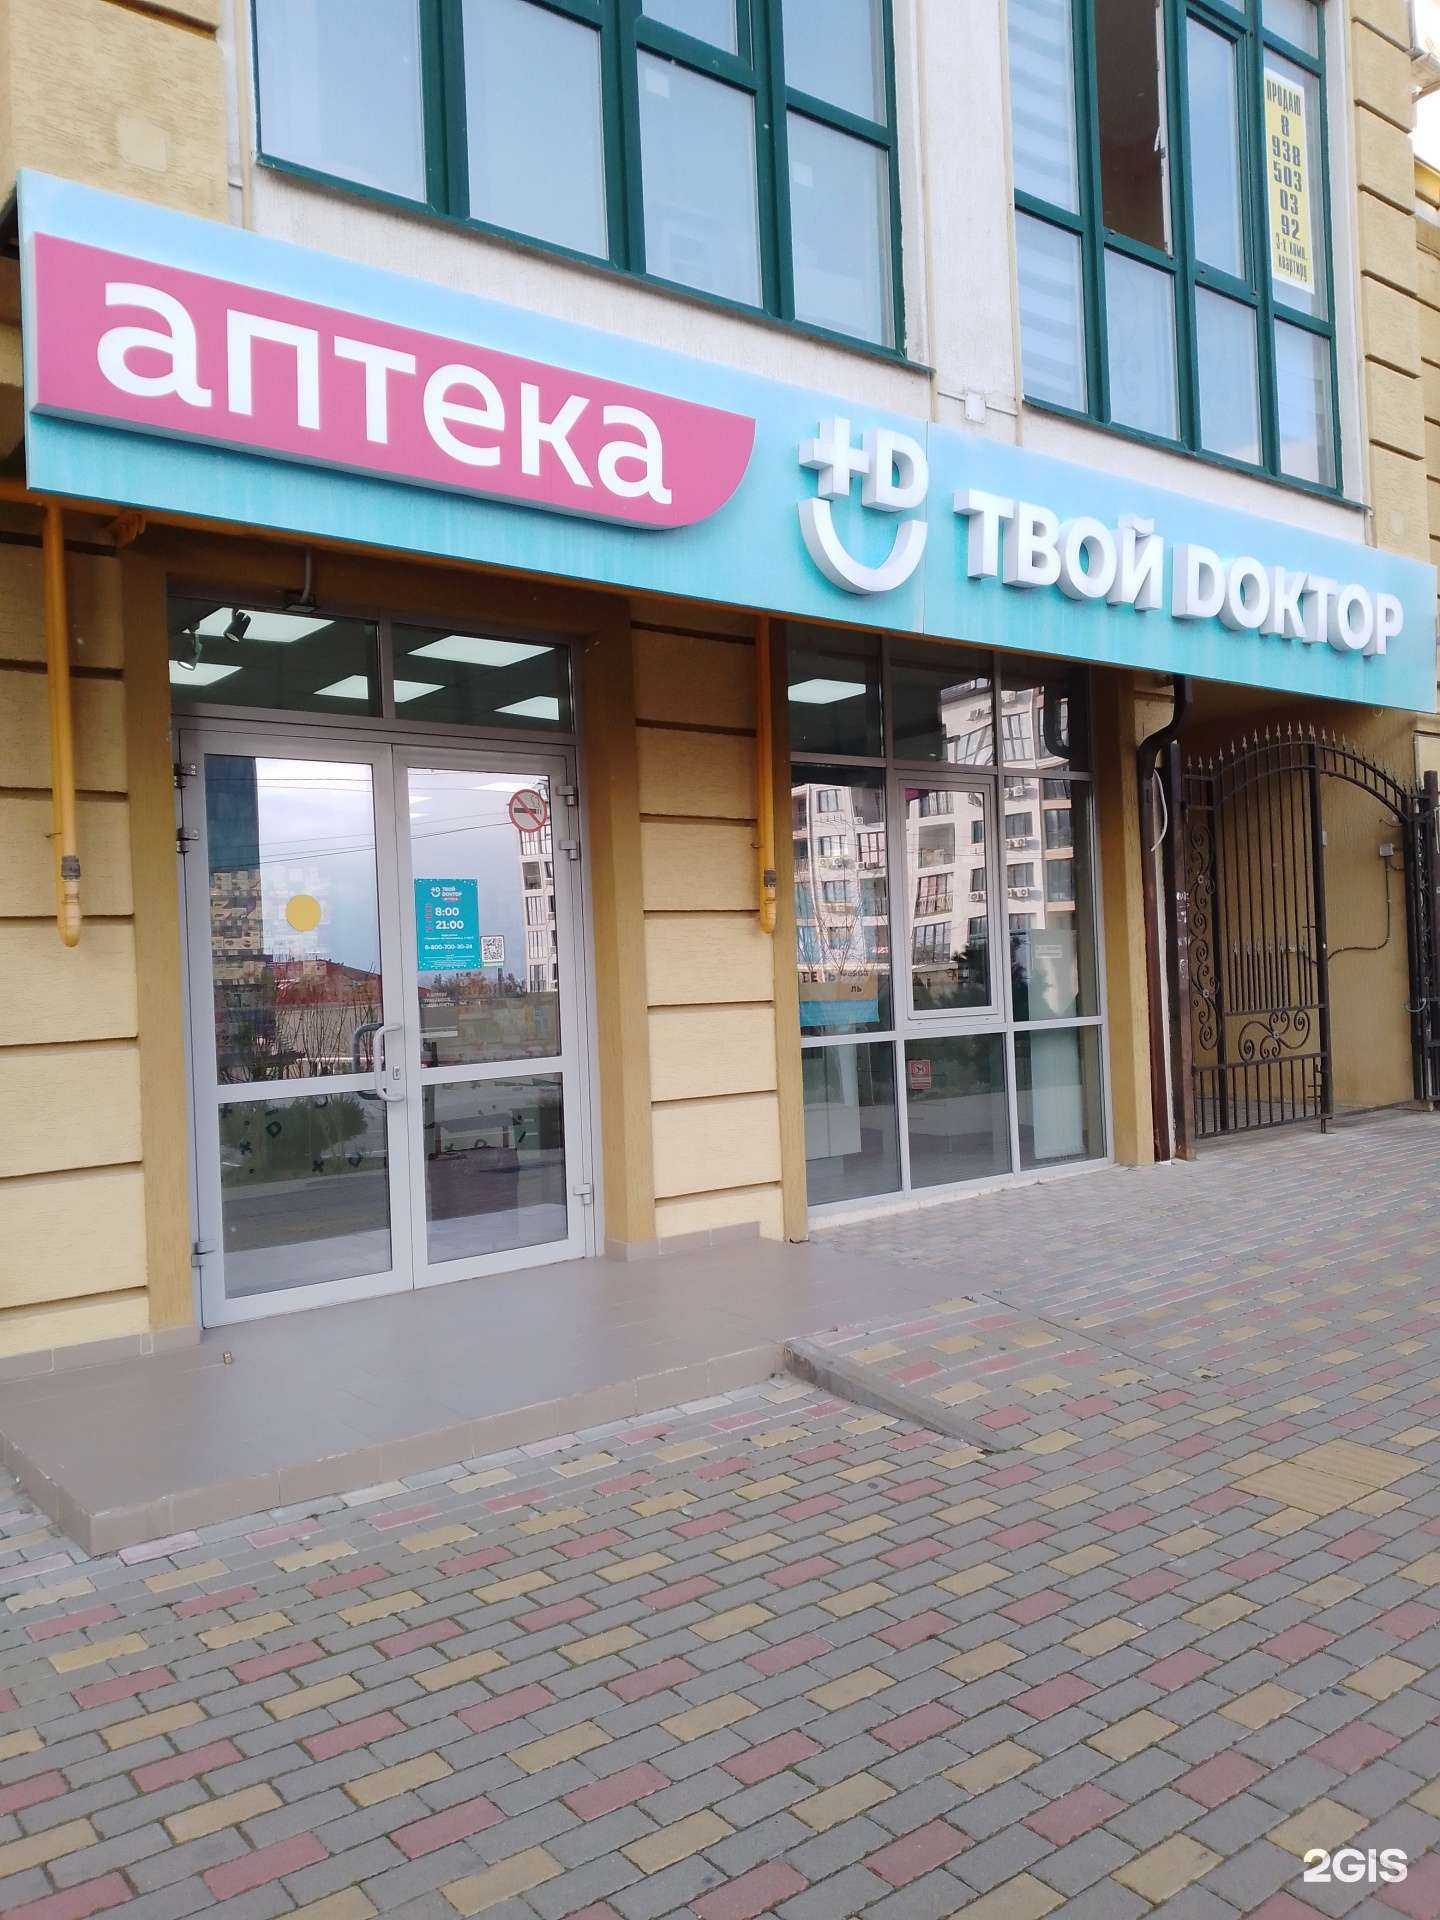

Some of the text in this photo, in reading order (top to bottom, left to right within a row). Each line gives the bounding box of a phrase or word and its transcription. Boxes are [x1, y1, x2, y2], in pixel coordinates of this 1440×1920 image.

[1266, 79, 1301, 116] ПРОДАЮ
[1281, 115, 1290, 137] 8
[1272, 134, 1301, 167] 938
[1273, 160, 1302, 192] 503
[1280, 189, 1299, 216] 03
[1281, 214, 1300, 241] 92
[96, 281, 673, 505] аптека
[952, 489, 1165, 612] ТВОЙ
[434, 906, 460, 917] 8:00
[435, 920, 465, 930] 21:00
